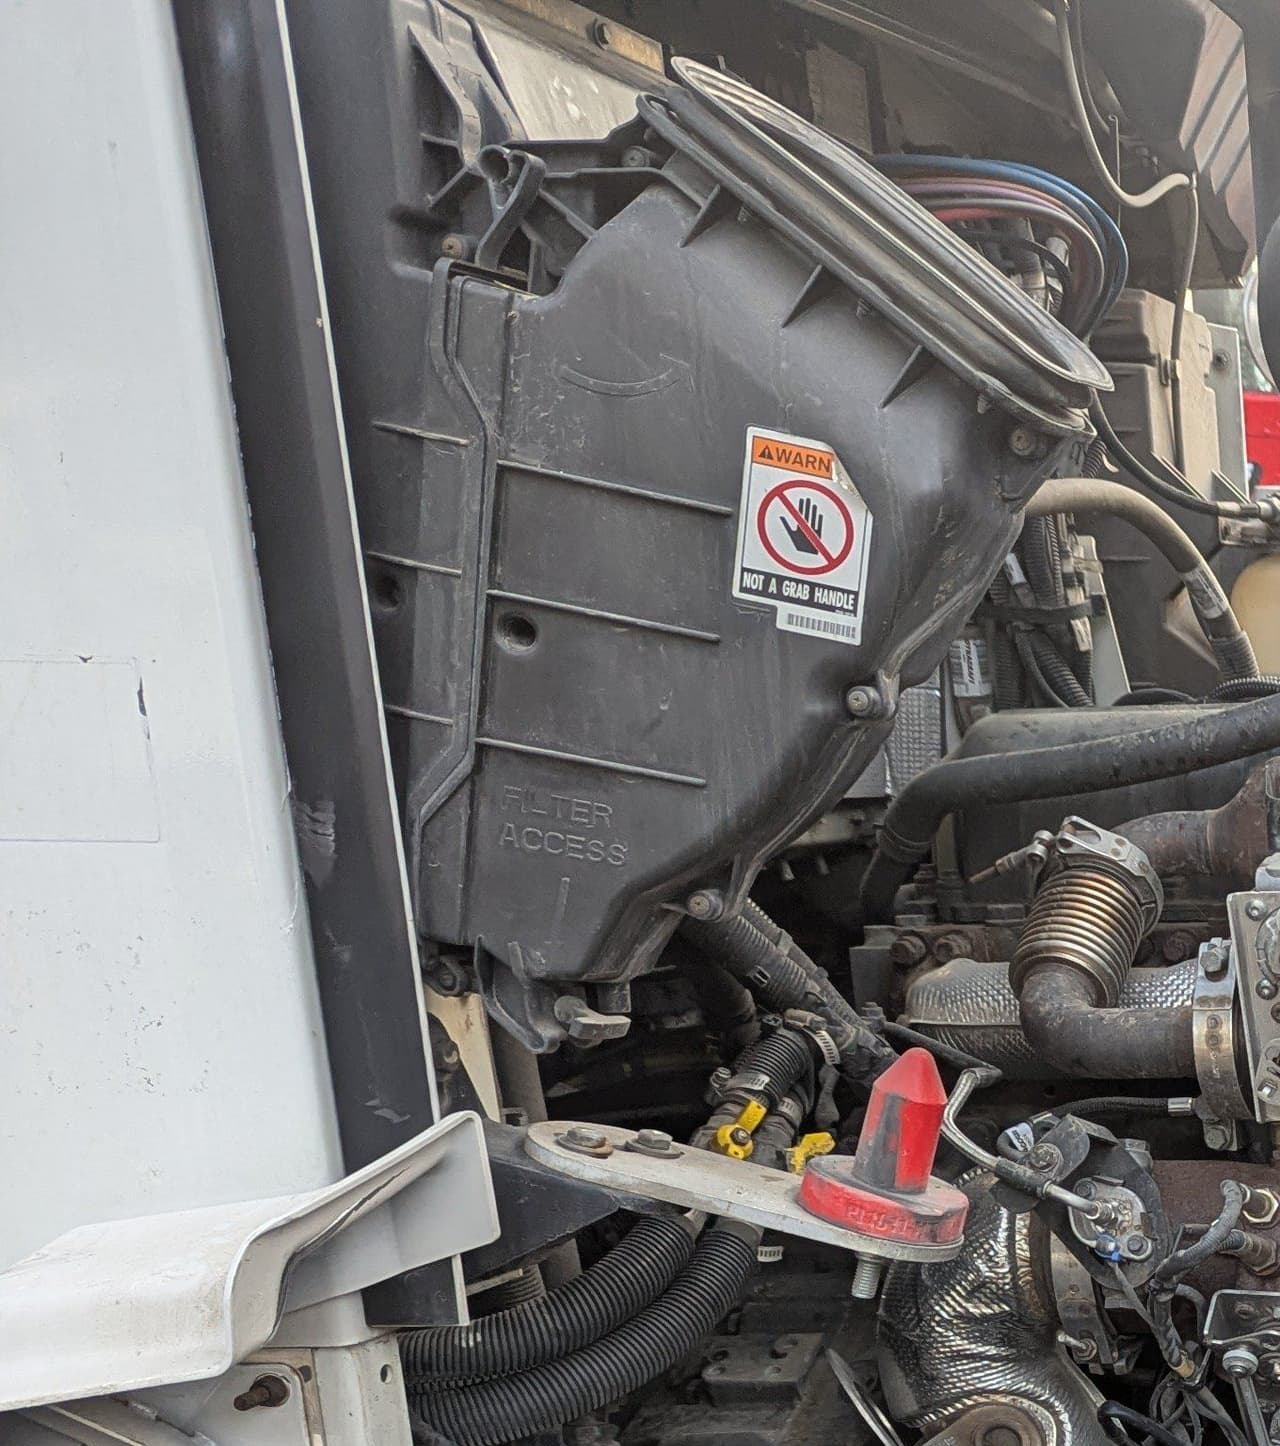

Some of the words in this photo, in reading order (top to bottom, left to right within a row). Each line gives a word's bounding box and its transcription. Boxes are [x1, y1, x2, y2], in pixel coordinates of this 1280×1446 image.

[776, 448, 832, 474] WARN
[742, 571, 764, 590] NOT
[768, 579, 777, 594] A
[782, 581, 810, 600] GRAB
[814, 587, 856, 610] HANDLE
[503, 785, 613, 828] FILTER
[499, 822, 629, 866] ACCESS
